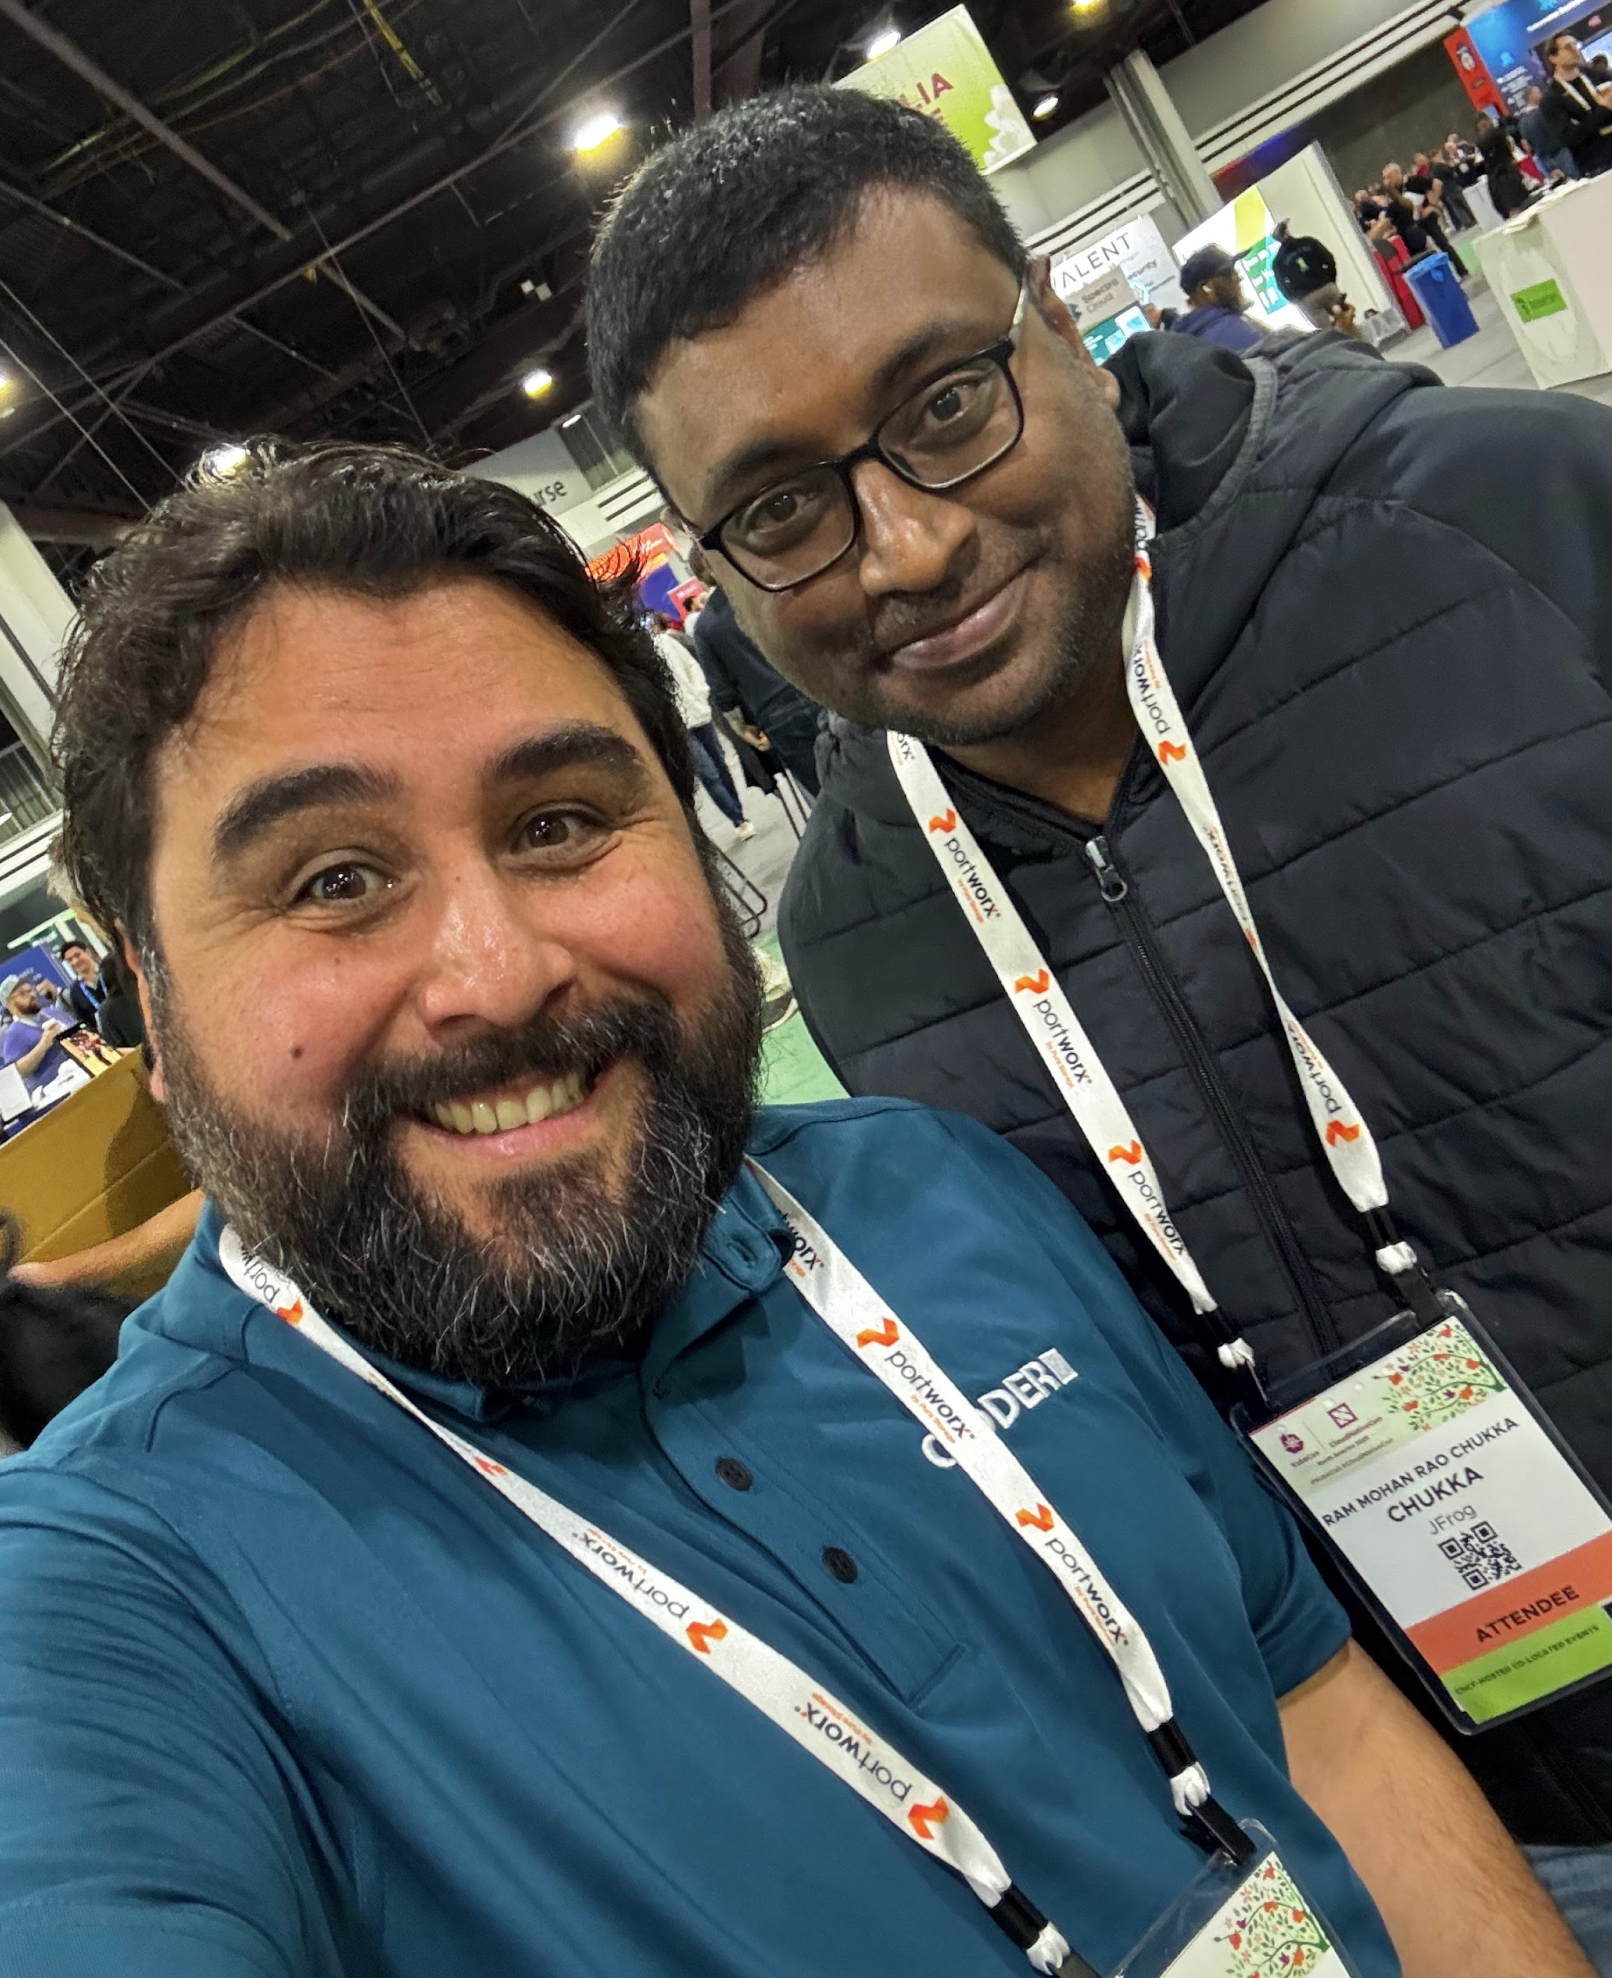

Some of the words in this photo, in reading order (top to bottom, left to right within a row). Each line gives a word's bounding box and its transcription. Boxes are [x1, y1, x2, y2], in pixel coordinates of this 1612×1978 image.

[944, 837, 998, 918] portworx
[1032, 999, 1090, 1083] portworx
[1128, 1170, 1187, 1257] portworx
[884, 1350, 971, 1439] portworx
[1322, 1503, 1359, 1527] RAM
[1356, 1472, 1415, 1508] MOHAN
[1414, 1454, 1450, 1479] RAO
[1449, 1417, 1519, 1458] CHUKKA
[1387, 1466, 1484, 1522] CHUKKA
[1430, 1505, 1477, 1535] JFrog
[578, 1528, 690, 1619] portworx
[1045, 1538, 1134, 1645] portworx
[1476, 1585, 1580, 1642] ATTENDEE
[801, 1702, 913, 1803] portworx
